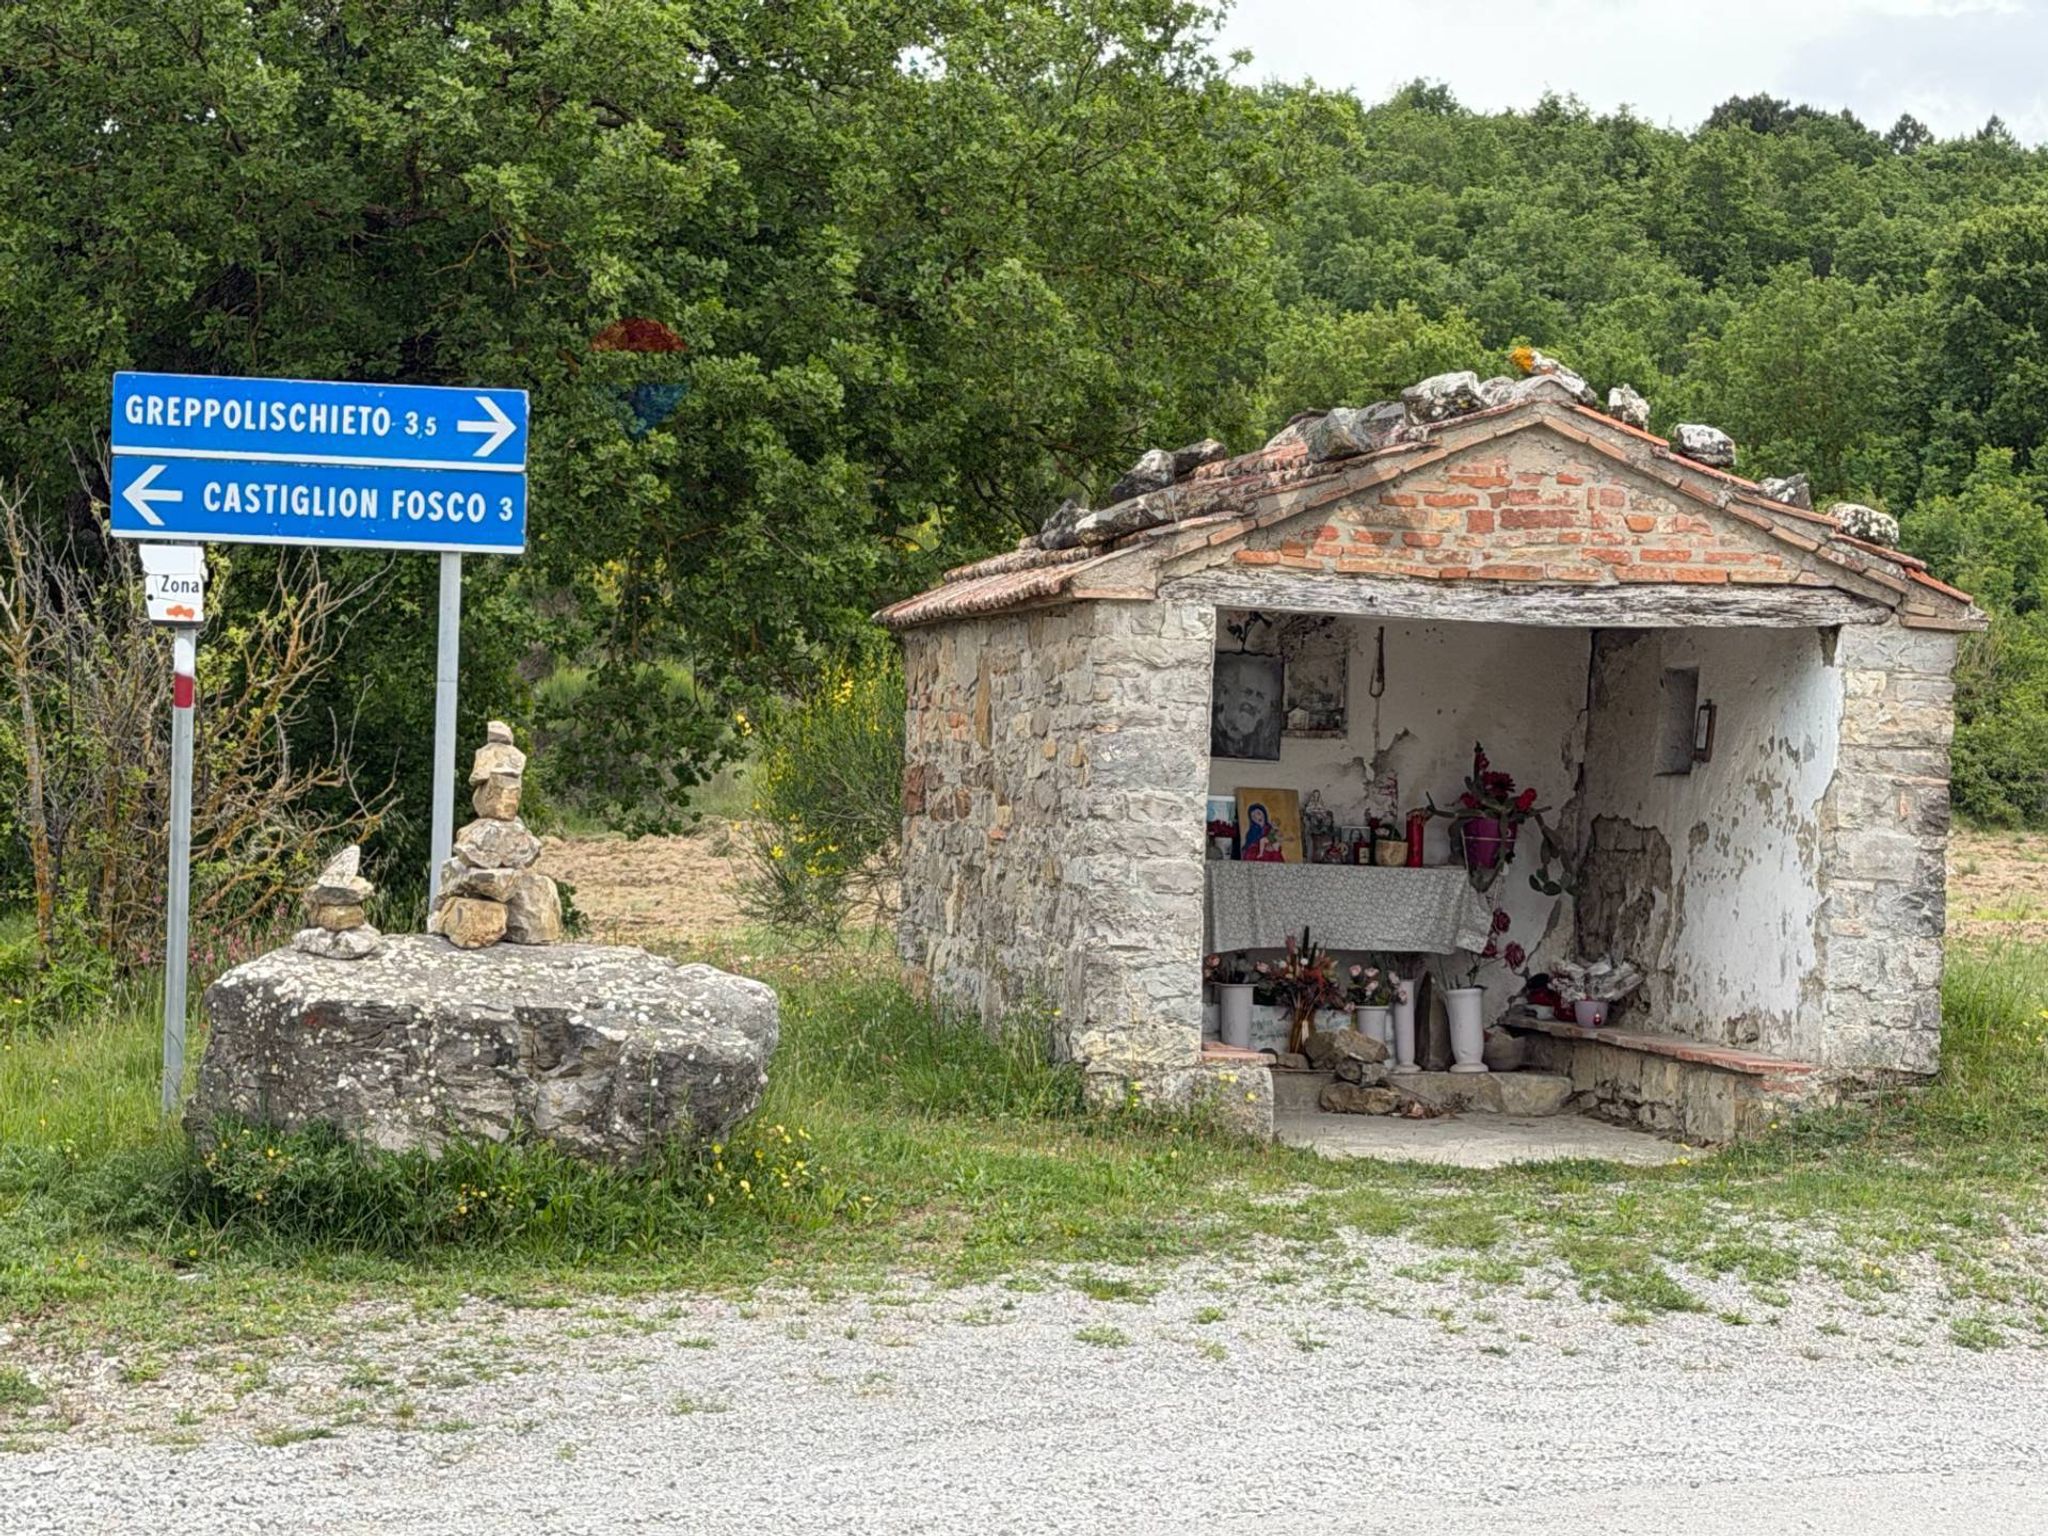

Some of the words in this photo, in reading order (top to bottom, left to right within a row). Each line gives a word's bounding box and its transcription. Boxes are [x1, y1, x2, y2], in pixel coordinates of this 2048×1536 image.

[125, 394, 391, 437] GREPPOLISCHIETO
[203, 481, 378, 519] CASTIGLION
[391, 489, 486, 523] FOSCO
[498, 496, 513, 521] 3
[160, 574, 200, 593] Zona
